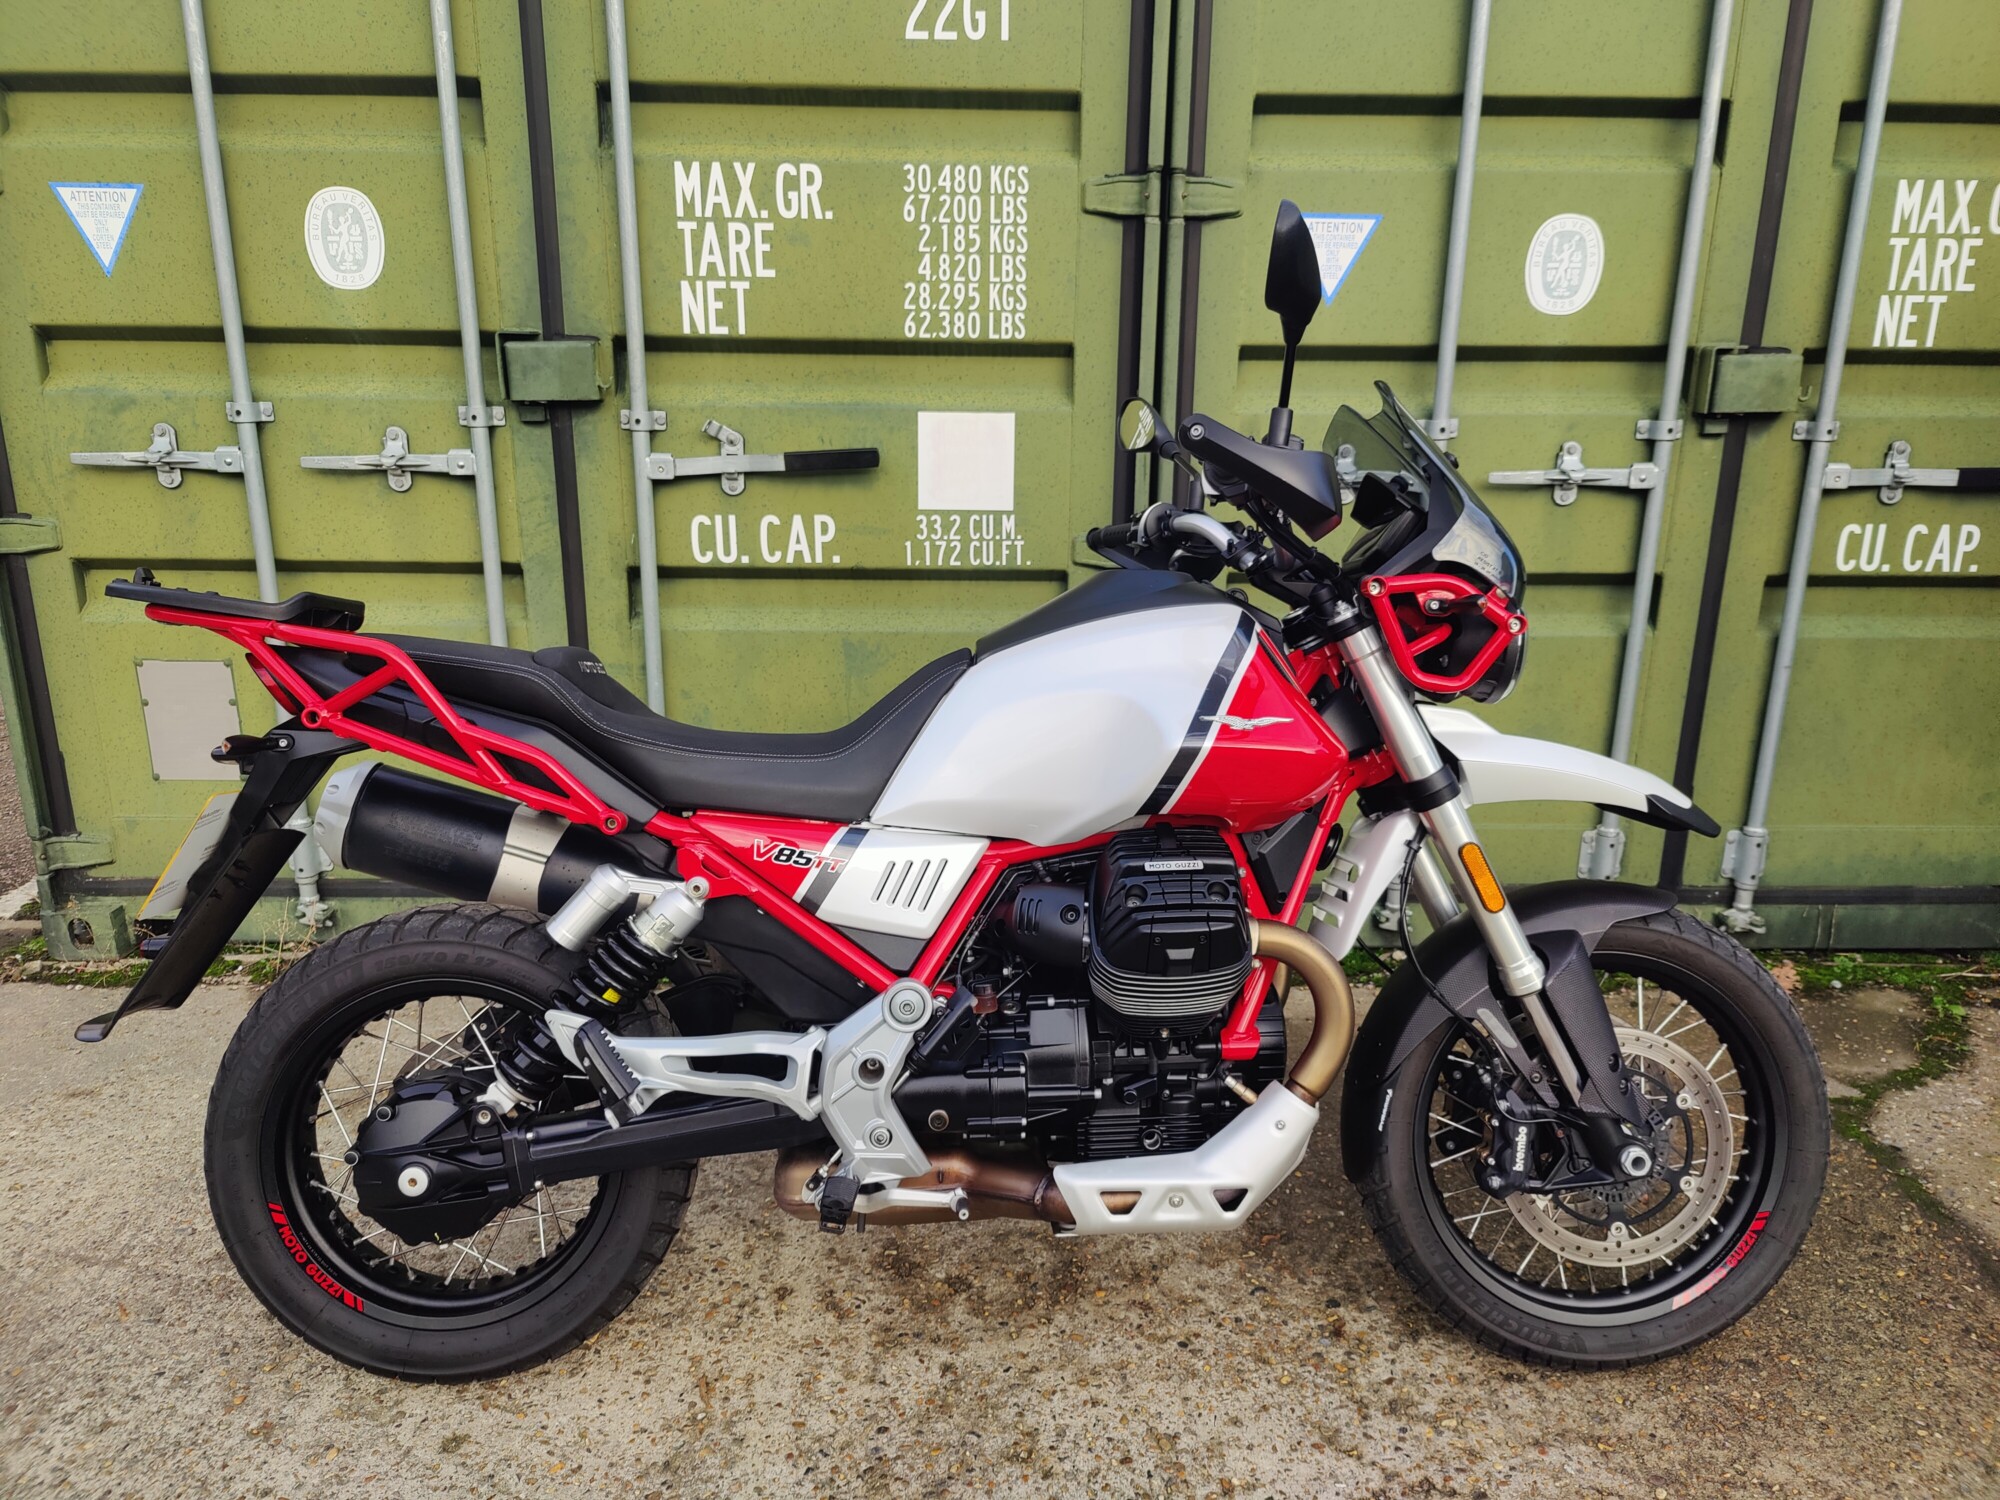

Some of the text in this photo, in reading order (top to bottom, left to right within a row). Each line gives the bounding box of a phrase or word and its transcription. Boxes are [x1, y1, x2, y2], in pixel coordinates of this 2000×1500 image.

[674, 161, 833, 219] MAX. GR.
[903, 163, 1029, 194] 30,480 KGS
[70, 190, 127, 202] ATTENTION
[903, 194, 1028, 224] 67,200 LBS
[1891, 178, 1982, 235] MAX.
[99, 211, 125, 219] REPAIRED
[312, 193, 377, 241] BUREAU VERITAS
[1308, 222, 1364, 233] ATTENTION
[95, 241, 113, 249] STEEL
[677, 221, 776, 277] TARE
[918, 224, 1028, 253] 2,185 KGS
[336, 273, 365, 283] 1828
[918, 253, 1027, 282] 4,820 LBS
[1888, 237, 1984, 291] TARE
[680, 280, 750, 335] NET
[904, 282, 1027, 311] 28,295 KGS
[904, 311, 1026, 340] 62,380 LBS
[1872, 294, 1948, 348] NET
[691, 514, 841, 564] CU. CAP.
[916, 514, 1022, 540] 33.2 CU.M.
[904, 540, 1032, 566] 1,172 CU.FT.
[1836, 523, 1981, 573] CU. CAP.
[1512, 1126, 1528, 1171] brembo
[278, 1225, 308, 1263] MOTO
[305, 1263, 345, 1298] GUZZI
[1725, 1231, 1758, 1268] GUZZI
[1440, 1265, 1553, 1347] MICHELIN
